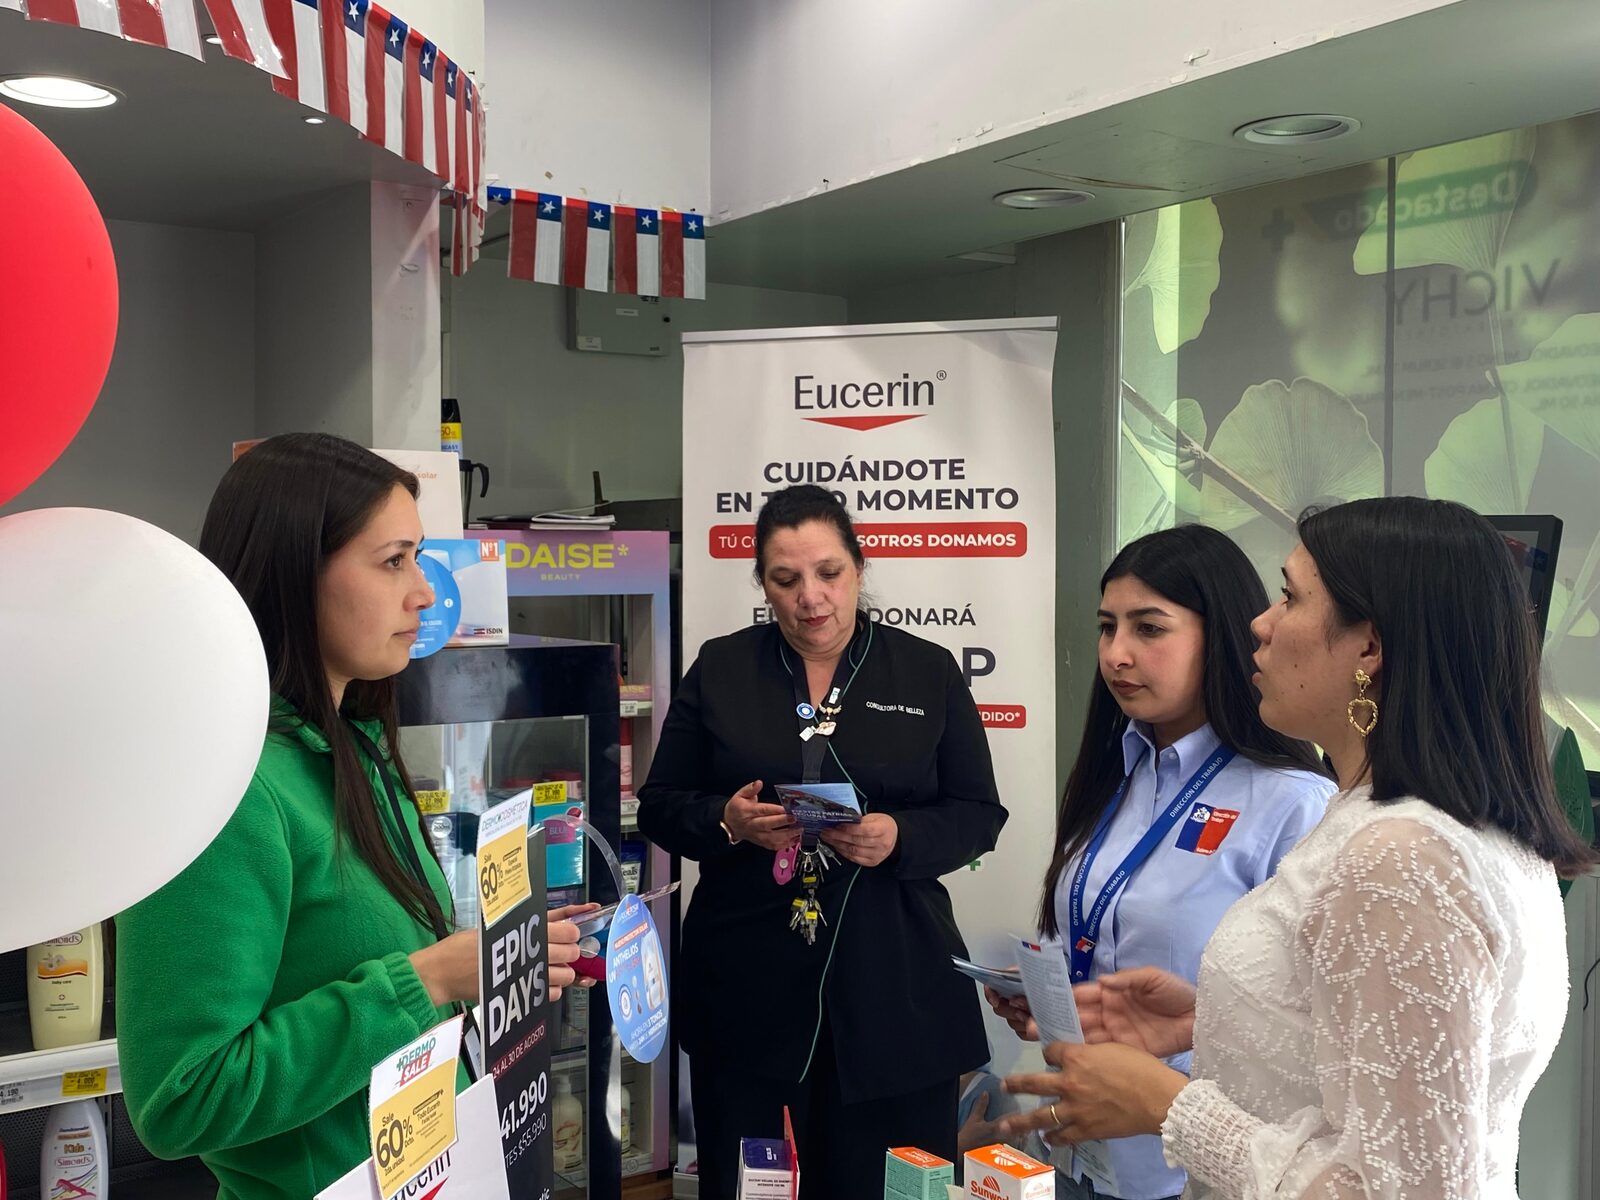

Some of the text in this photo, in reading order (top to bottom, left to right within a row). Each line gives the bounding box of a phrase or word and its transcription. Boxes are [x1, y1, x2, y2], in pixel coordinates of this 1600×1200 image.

[763, 455, 966, 484] CUIDÁNDOTE
[716, 492, 752, 513] EN
[857, 487, 1019, 511] MOMENTO
[718, 533, 737, 549] TÚ
[856, 534, 923, 547] SOTROS
[928, 533, 1017, 547] DONAMOS
[540, 573, 581, 581] BEAUTY
[867, 603, 976, 626] DONARÁ
[491, 913, 541, 989] EPIC
[488, 961, 546, 1047] DAYS
[500, 1058, 508, 1073] AL
[508, 1050, 516, 1066] 30
[515, 1043, 524, 1061] DE
[524, 1024, 546, 1050] AGOSTO
[403, 1053, 428, 1081] SALE
[382, 1112, 394, 1127] Sale
[504, 1148, 518, 1169] TES
